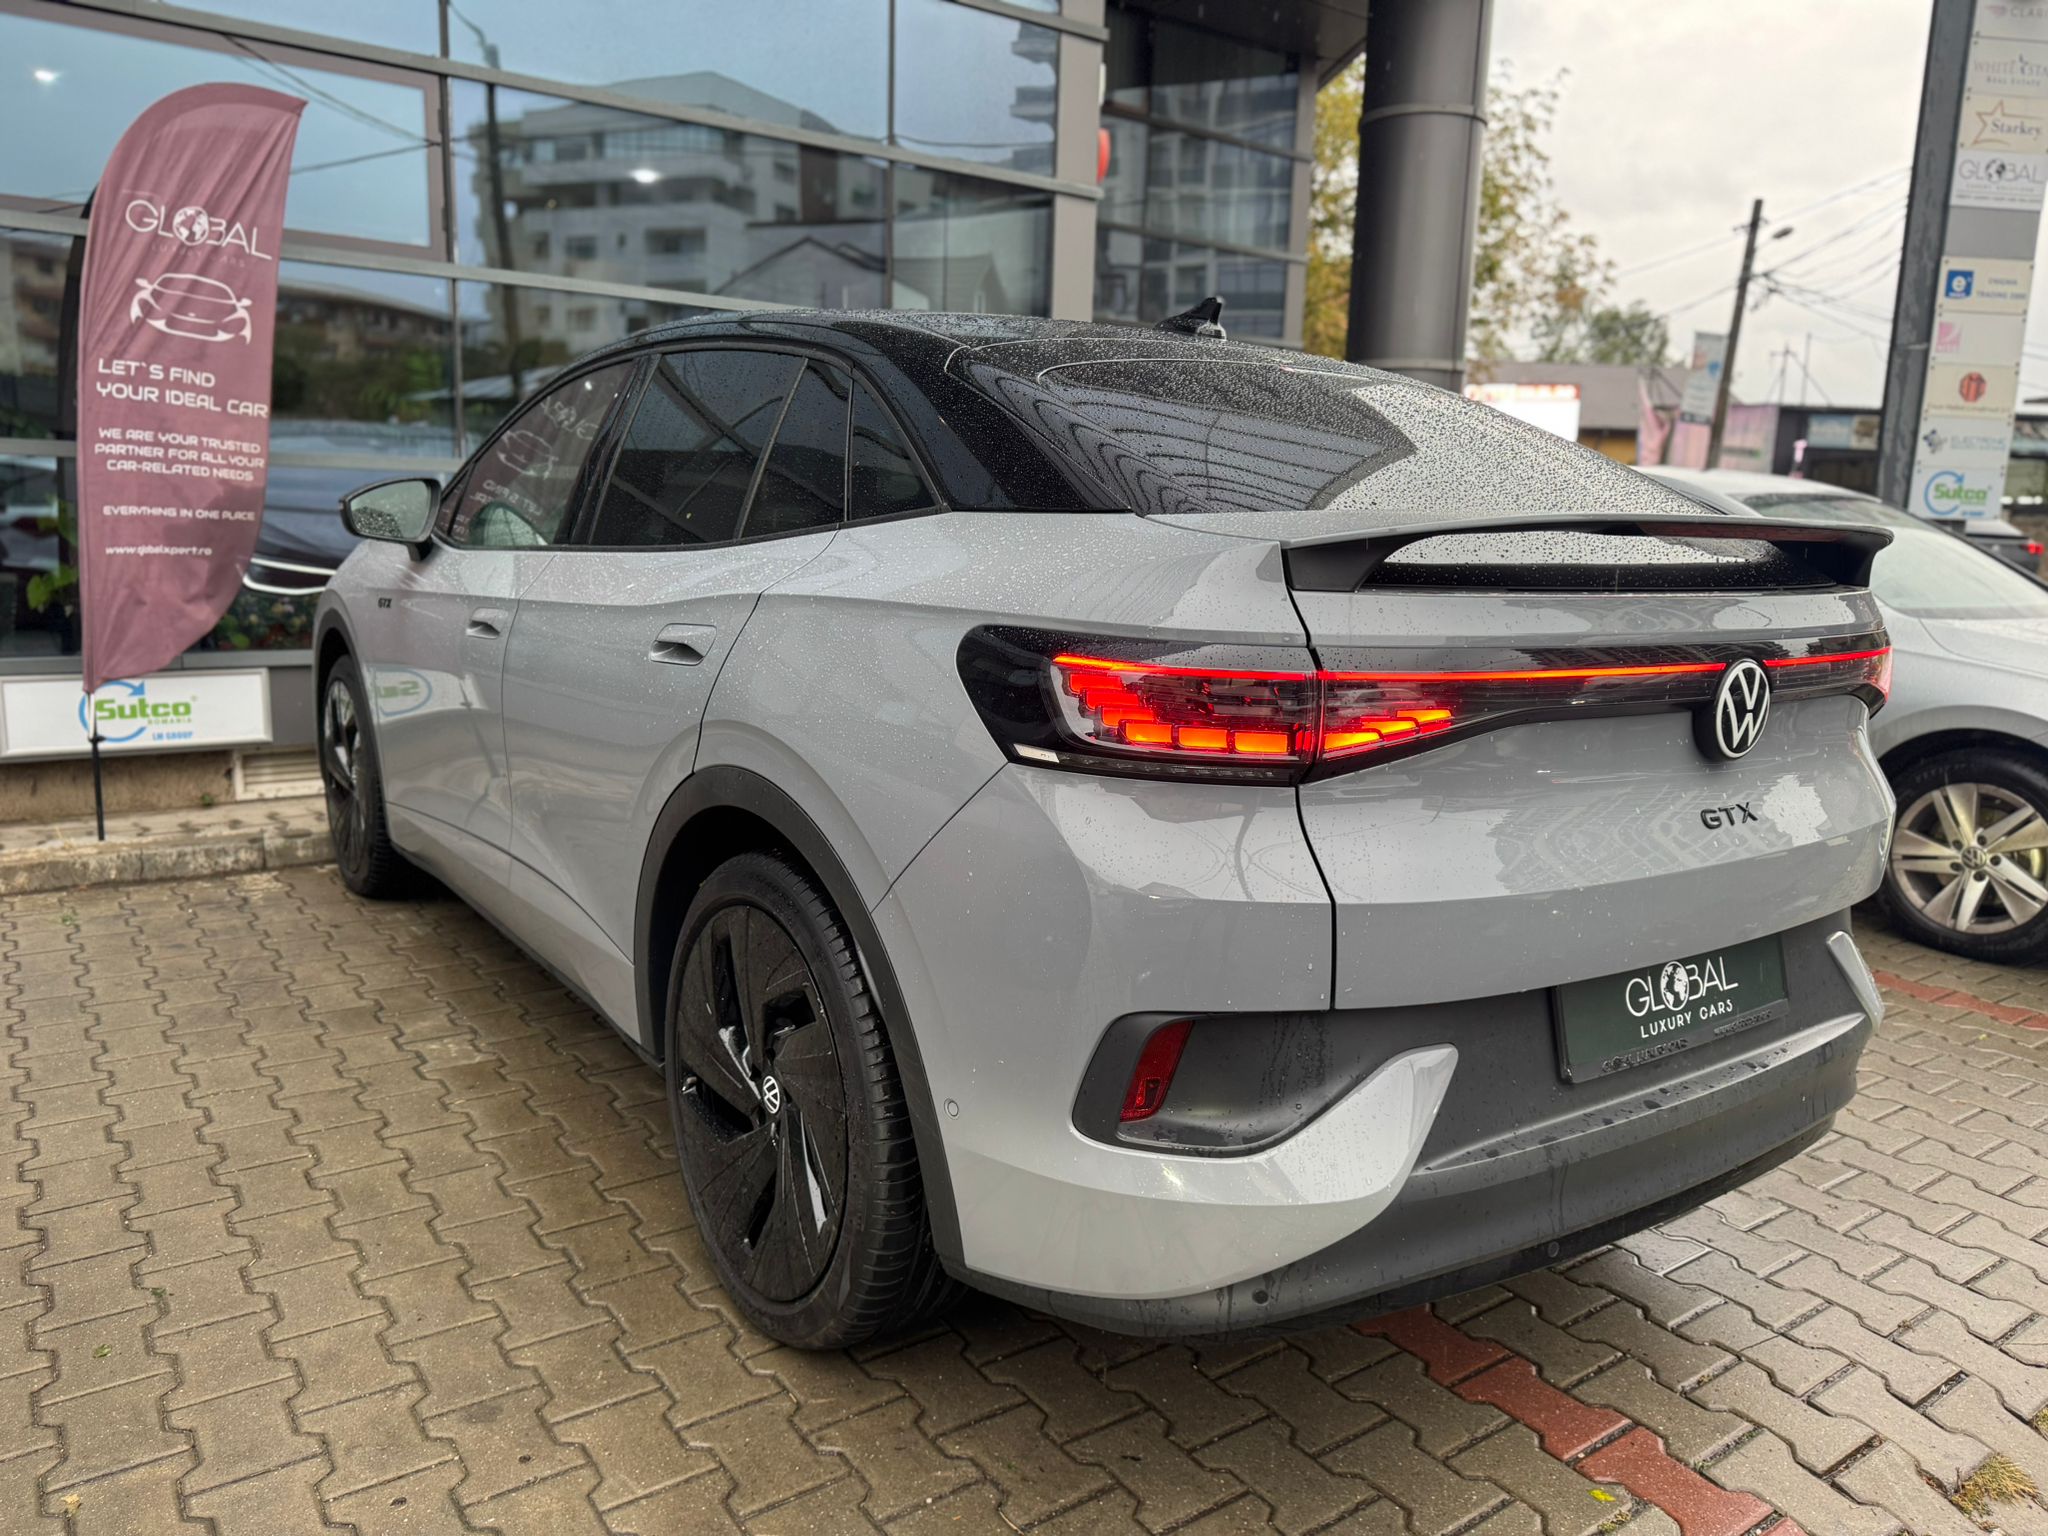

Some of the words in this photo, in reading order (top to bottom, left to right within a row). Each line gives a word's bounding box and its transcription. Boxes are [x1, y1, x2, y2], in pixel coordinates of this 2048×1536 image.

[1991, 118, 2042, 140] Starkey
[1958, 158, 2045, 185] GLOBAL
[126, 199, 272, 260] GLOBAL
[169, 367, 215, 387] FIND
[96, 381, 159, 402] YOUR
[165, 390, 221, 412] IDEAL
[227, 399, 268, 418] CAR
[98, 427, 122, 440] WE
[126, 429, 154, 442] ARE
[158, 431, 198, 446] YOUR
[201, 436, 261, 454] TRUSTED
[95, 443, 164, 458] PARTNER
[168, 447, 198, 461] FOR
[201, 450, 227, 464] ALL
[229, 455, 265, 469] YOUR
[106, 459, 210, 477] CAR-RELATED
[213, 467, 254, 482] NEEDS
[1933, 482, 1989, 501] Sutco
[103, 505, 177, 518] EVERYTHING
[180, 508, 193, 518] IN
[195, 508, 220, 520] ONE
[222, 510, 255, 521] PLACE
[378, 597, 392, 609] GTX
[94, 698, 192, 720] Sutco
[166, 731, 193, 740] GROUP
[1700, 802, 1759, 830] GTX
[1625, 956, 1739, 1017] GLOBAL
[1640, 1011, 1693, 1039] LUXURY
[1699, 999, 1734, 1020] CARS
